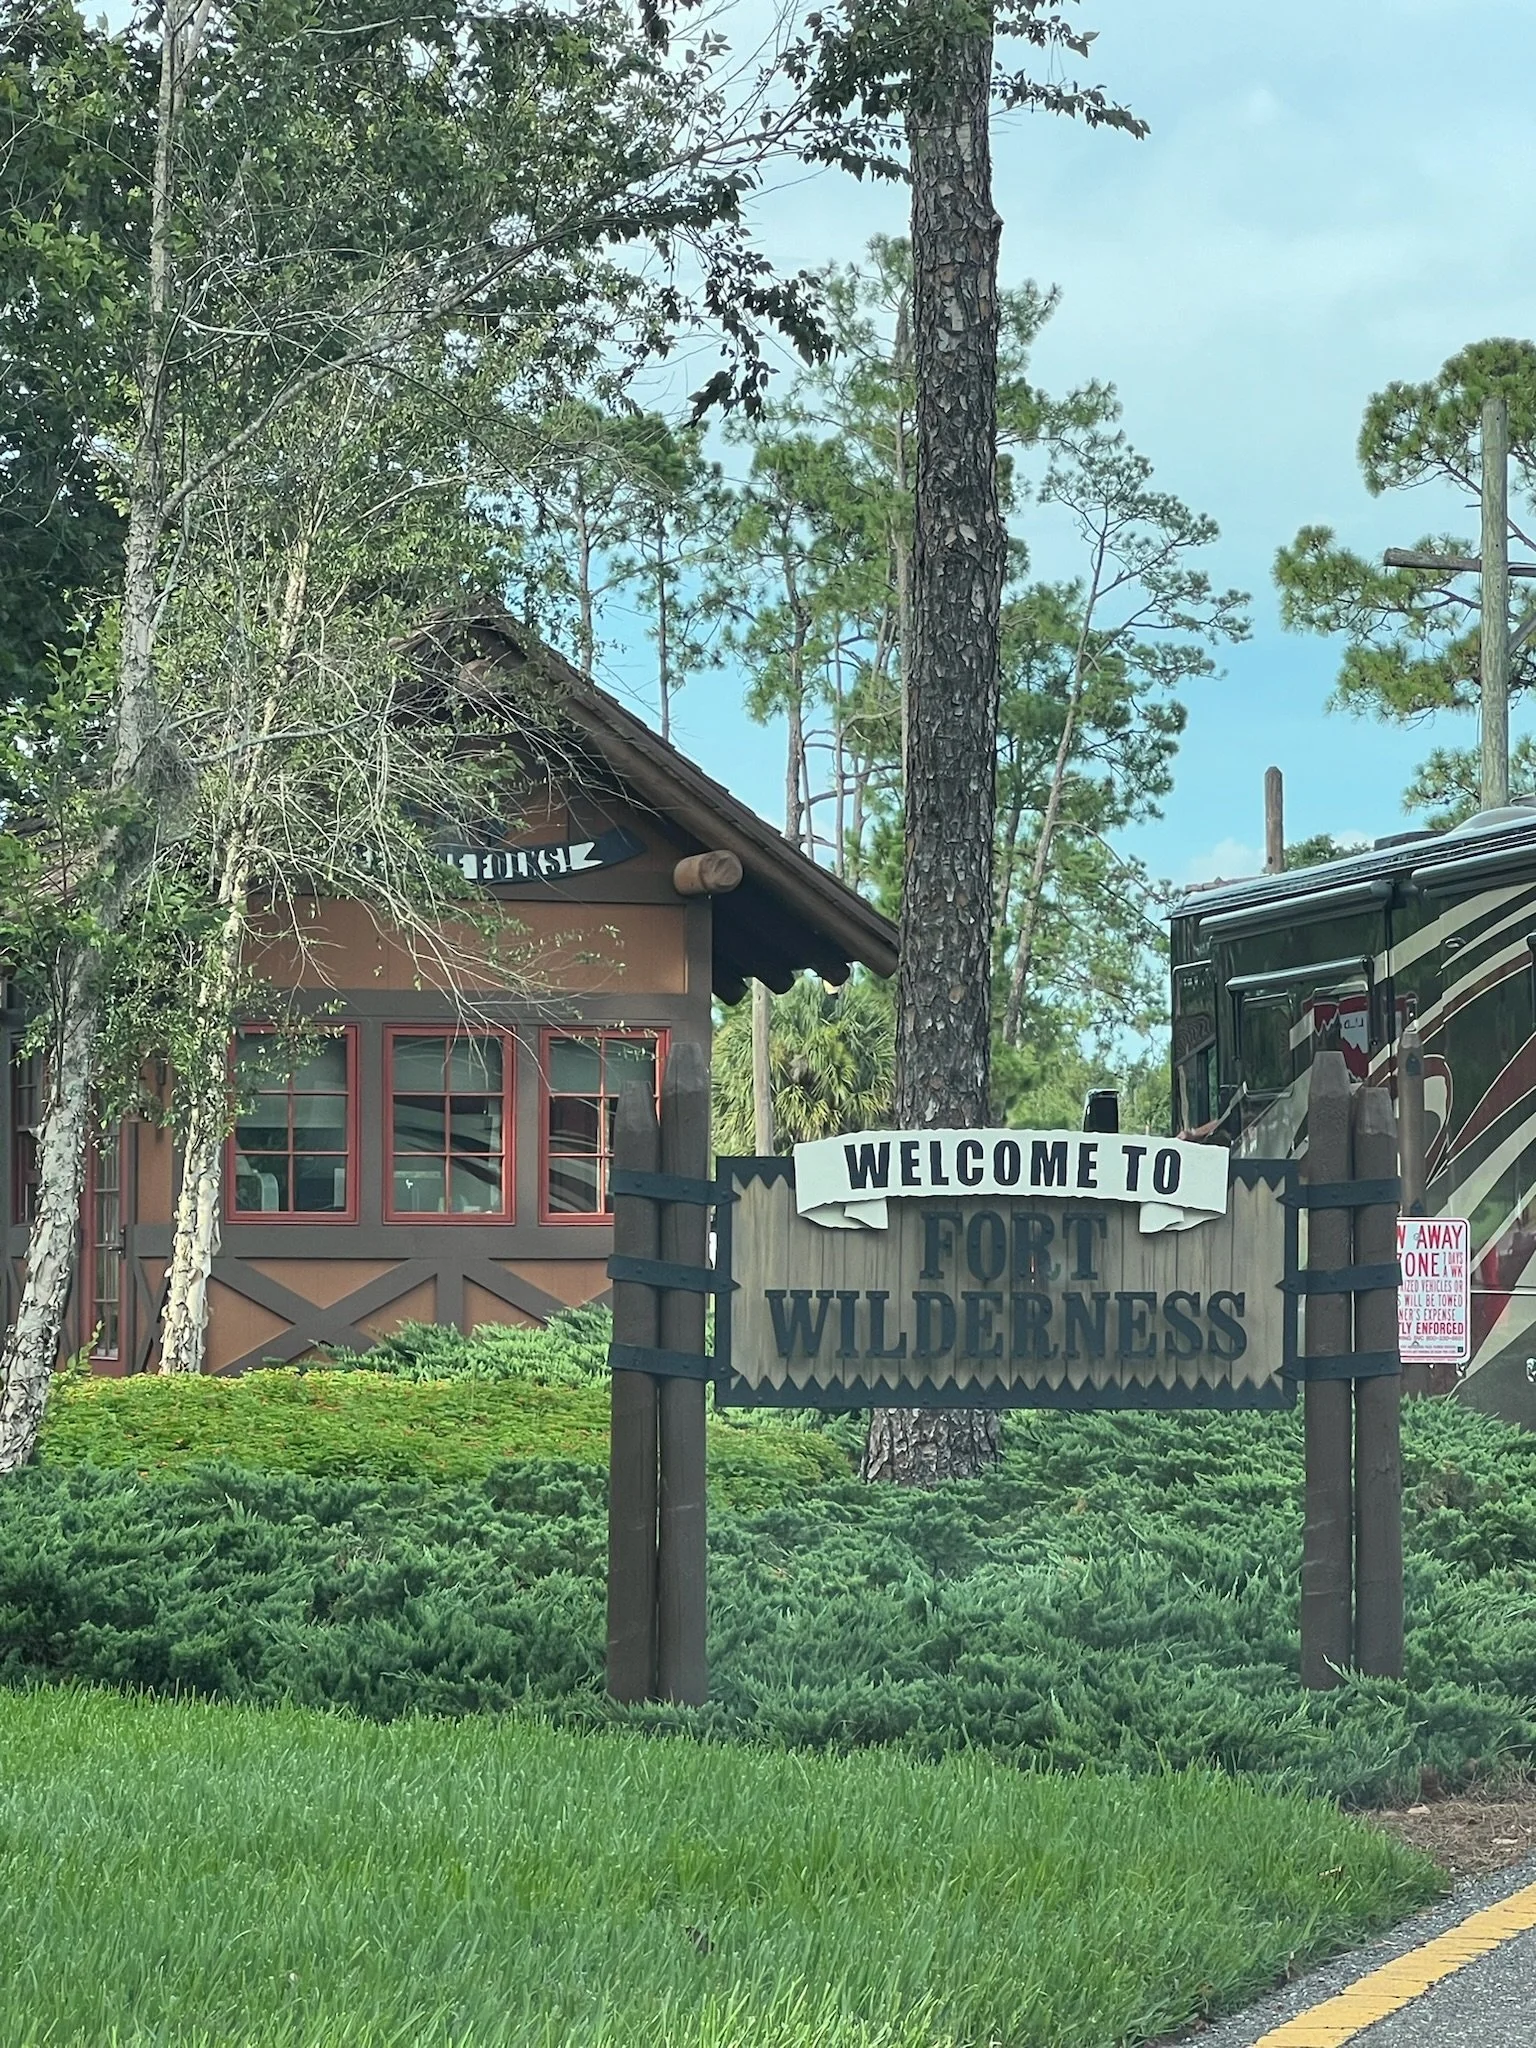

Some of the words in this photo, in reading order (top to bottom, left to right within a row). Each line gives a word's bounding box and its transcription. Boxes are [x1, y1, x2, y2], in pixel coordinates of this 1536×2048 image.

[843, 1138, 1099, 1191] WELCOME
[1121, 1144, 1182, 1196] TO
[1416, 1225, 1463, 1249] AWAY
[918, 1209, 1108, 1282] FORT
[1448, 1252, 1463, 1264] DAYS
[1442, 1265, 1448, 1277] A
[1451, 1266, 1463, 1277] WK
[1421, 1280, 1452, 1292] VEHICLES
[1454, 1280, 1463, 1292] OR
[1405, 1294, 1422, 1307] WILL
[1426, 1294, 1435, 1307] BE
[1438, 1294, 1463, 1307] TOWED
[1398, 1308, 1420, 1321] NER'S
[1424, 1308, 1456, 1321] EXPENSE
[764, 1289, 1248, 1362] WILDERNESS
[1416, 1322, 1463, 1335] ENFORCED
